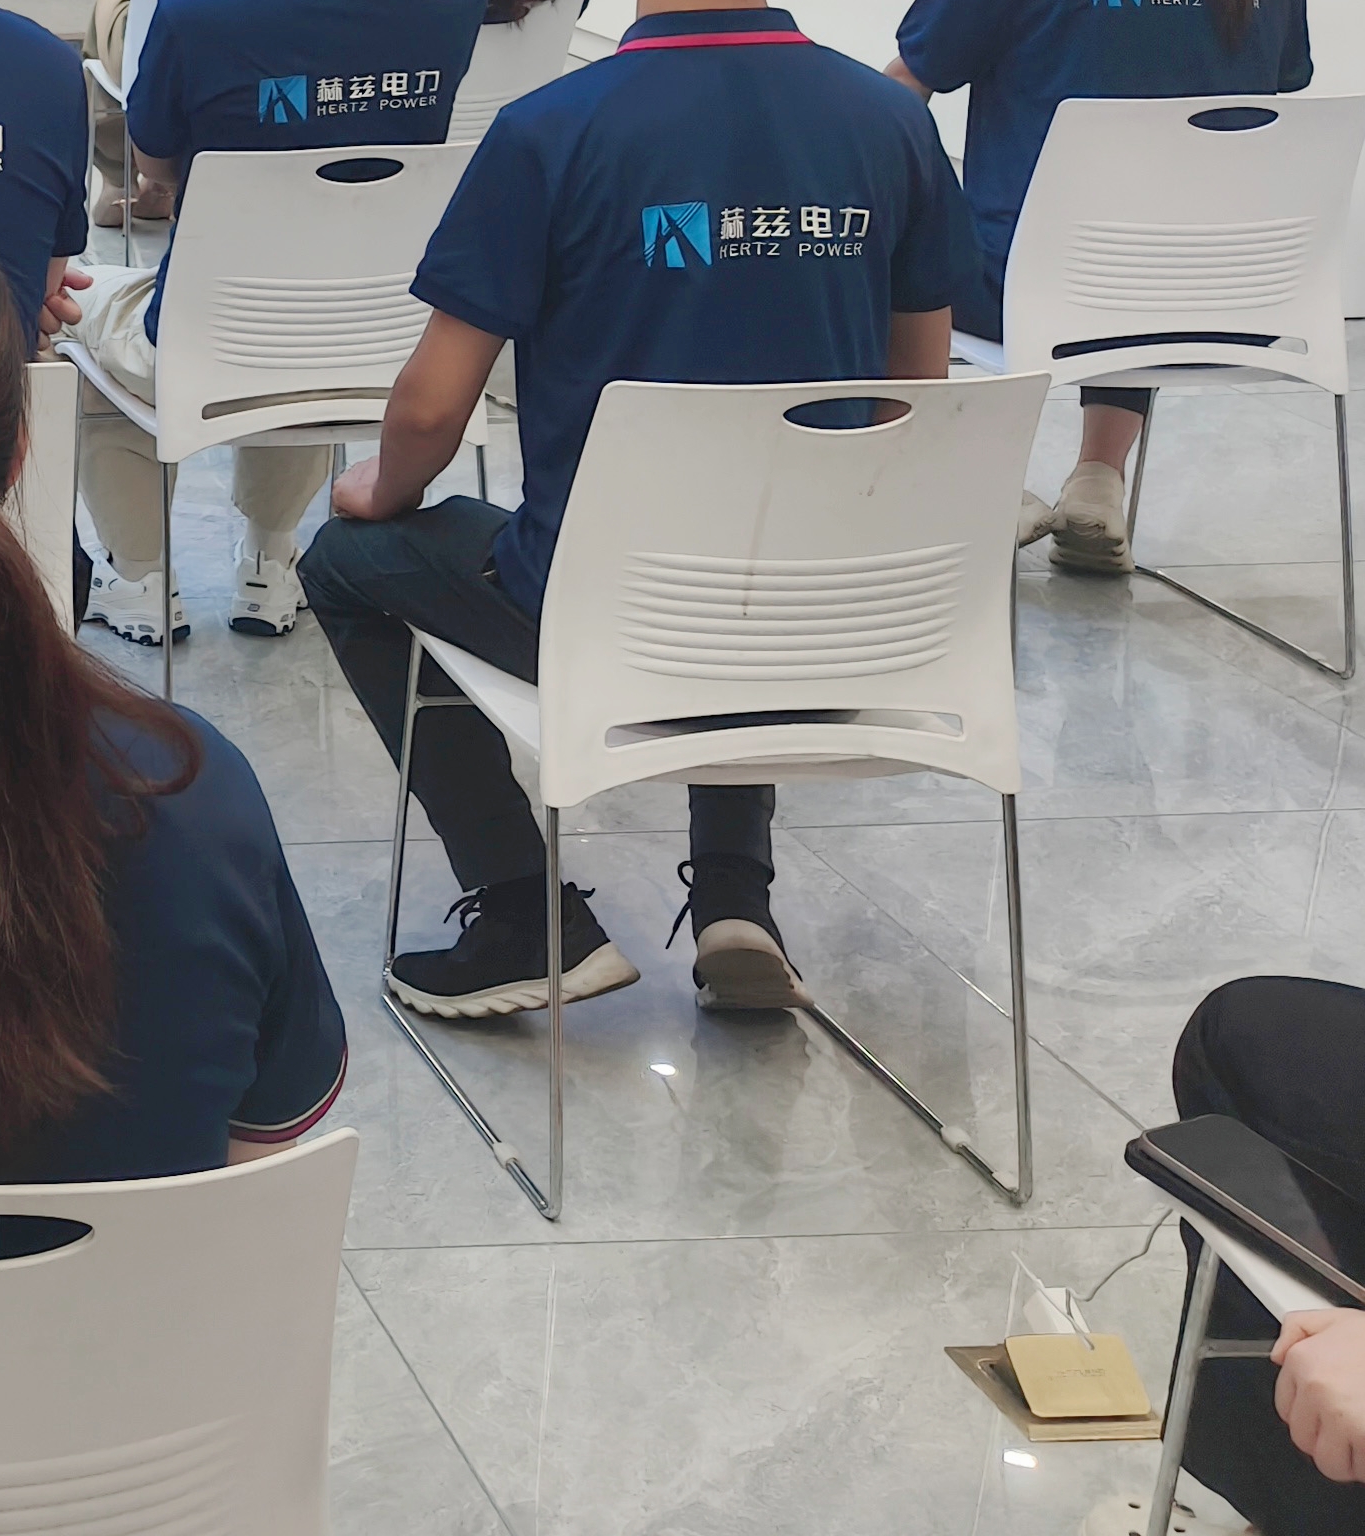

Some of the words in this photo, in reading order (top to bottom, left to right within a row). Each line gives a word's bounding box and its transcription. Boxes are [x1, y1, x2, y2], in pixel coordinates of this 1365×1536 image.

[316, 70, 441, 103] 赫兹电力
[316, 101, 369, 117] HERTZ
[380, 94, 437, 111] POWER
[720, 205, 870, 240] 赫兹电力
[719, 241, 781, 260] HERTZ
[798, 242, 864, 257] POWER
